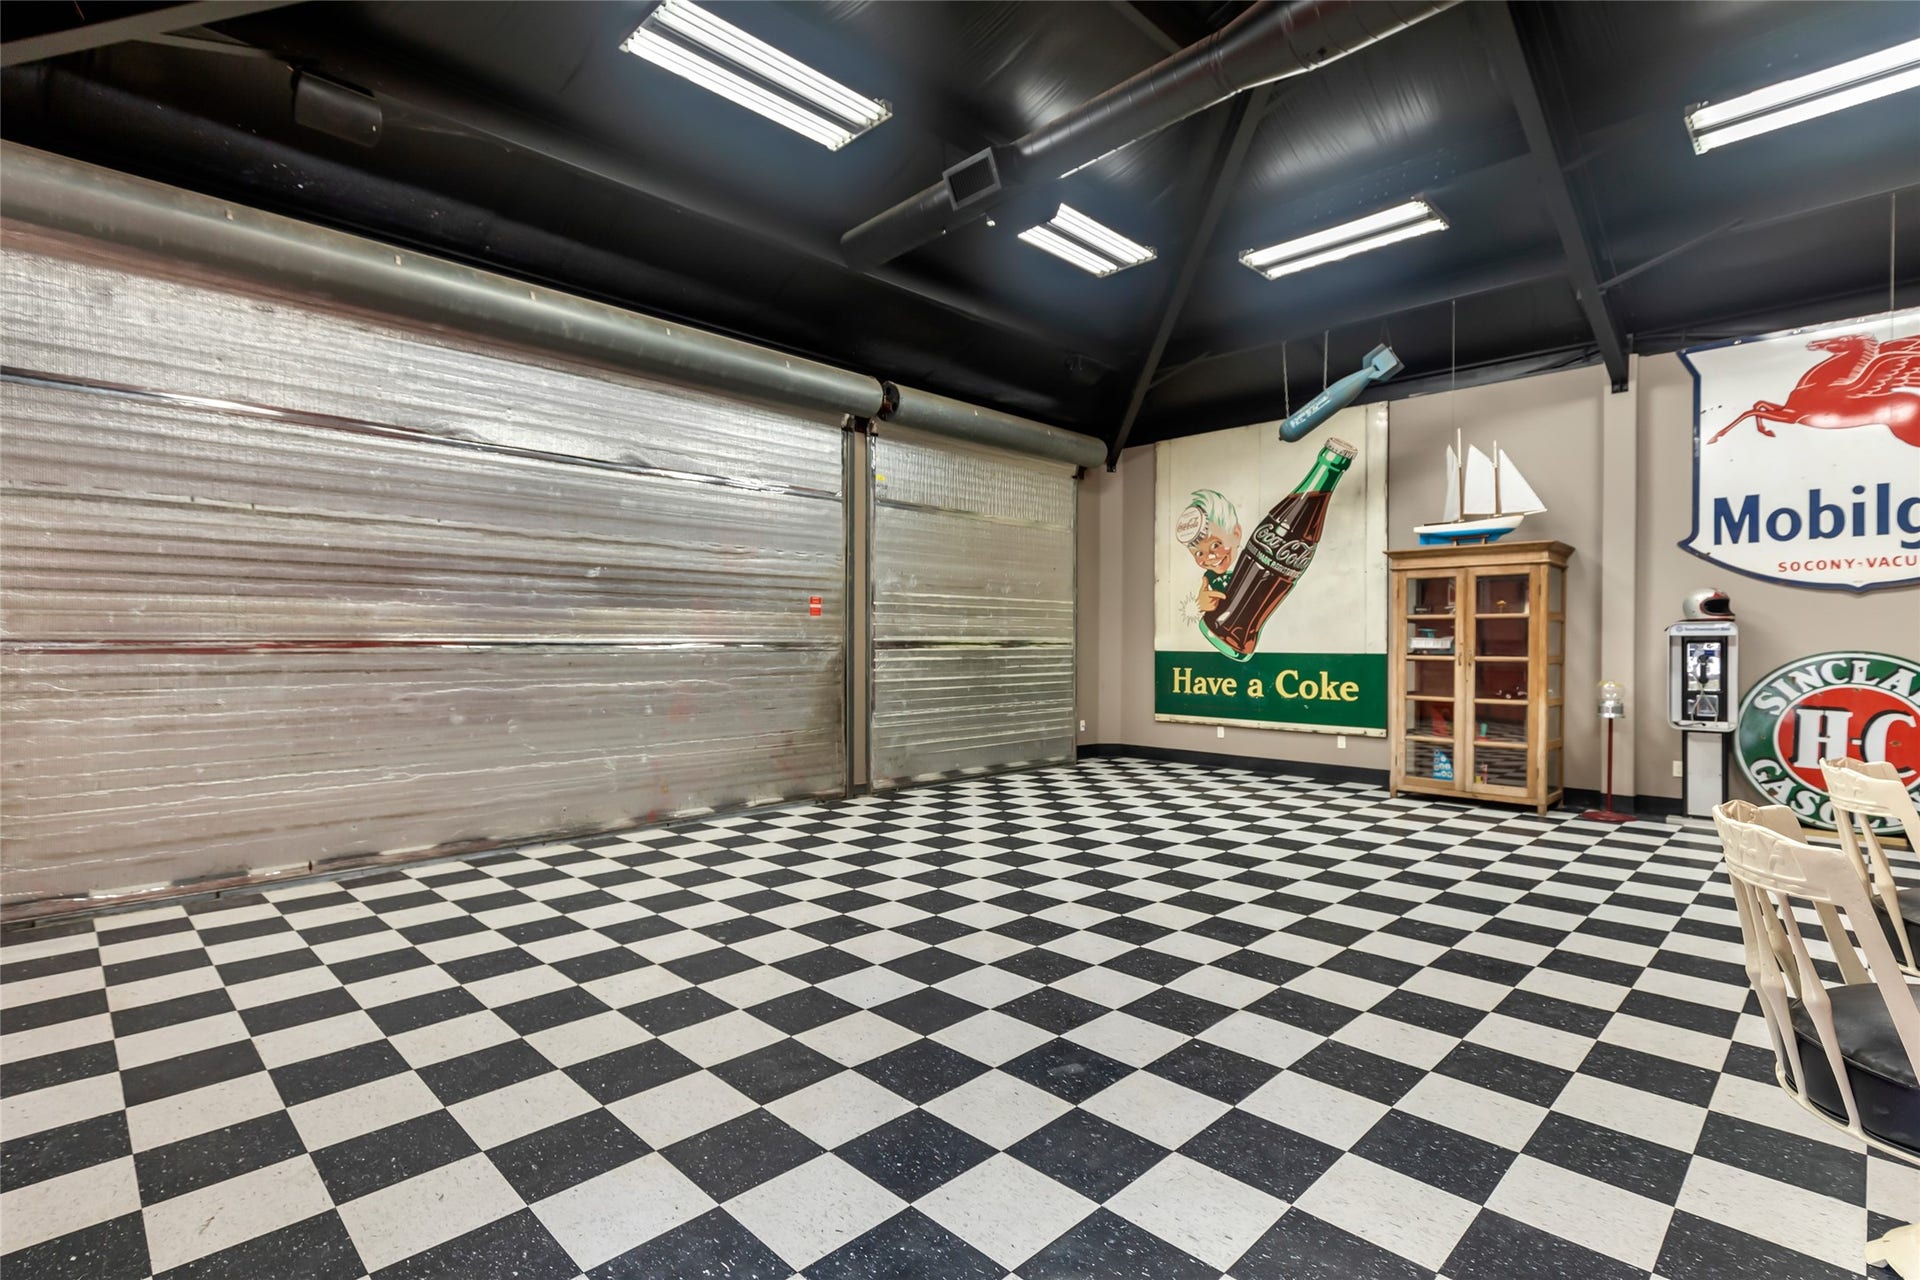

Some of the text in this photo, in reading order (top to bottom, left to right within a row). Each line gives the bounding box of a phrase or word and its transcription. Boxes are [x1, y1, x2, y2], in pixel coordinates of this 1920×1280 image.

[1253, 523, 1315, 570] Coca-Cola
[1172, 667, 1359, 702] Have a Coke
[1753, 660, 1920, 715] SINCLA
